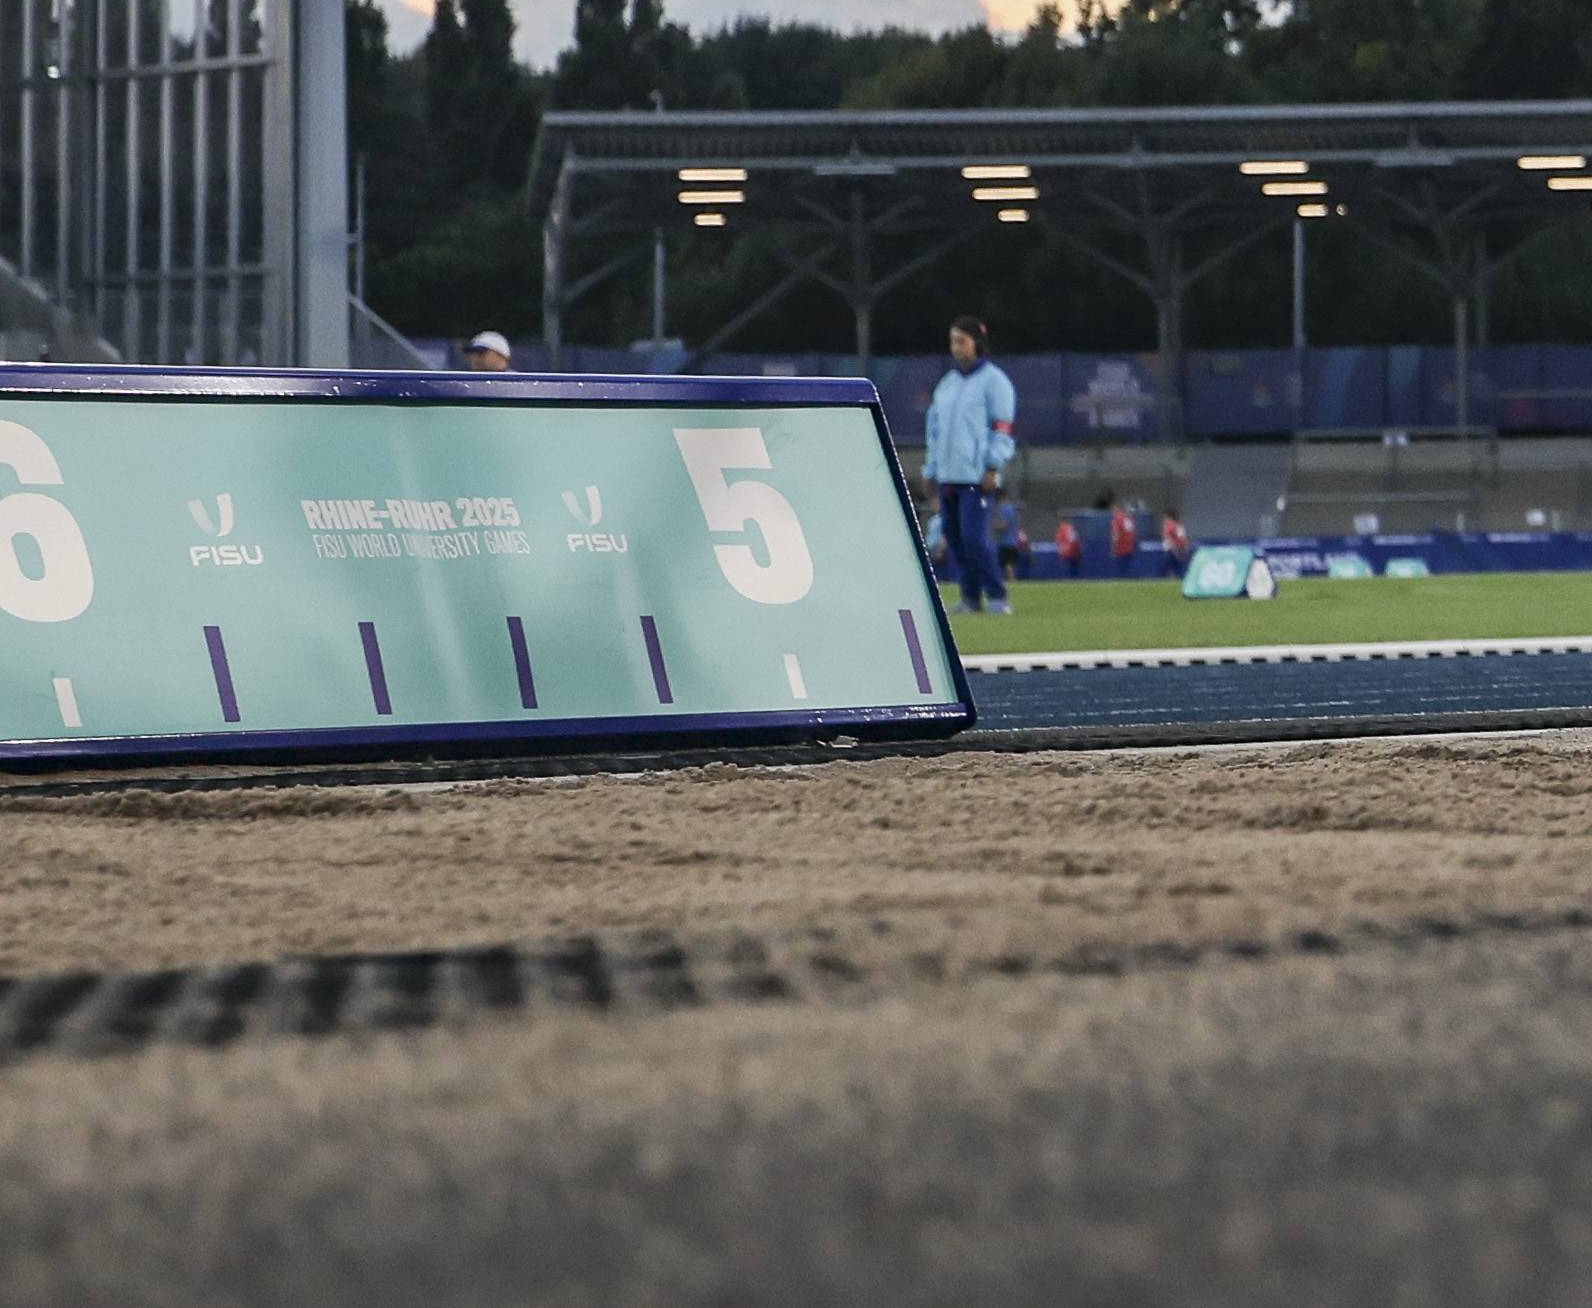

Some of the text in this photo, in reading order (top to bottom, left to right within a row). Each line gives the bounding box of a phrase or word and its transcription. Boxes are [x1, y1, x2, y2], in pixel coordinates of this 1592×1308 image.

[301, 497, 521, 531] RHINE-RUHR 2025
[673, 427, 814, 605] 5
[190, 545, 264, 566] FISU
[312, 534, 347, 559] FISU
[347, 533, 401, 558] WORLD
[483, 530, 531, 555] GAMES
[567, 533, 628, 553] FISU
